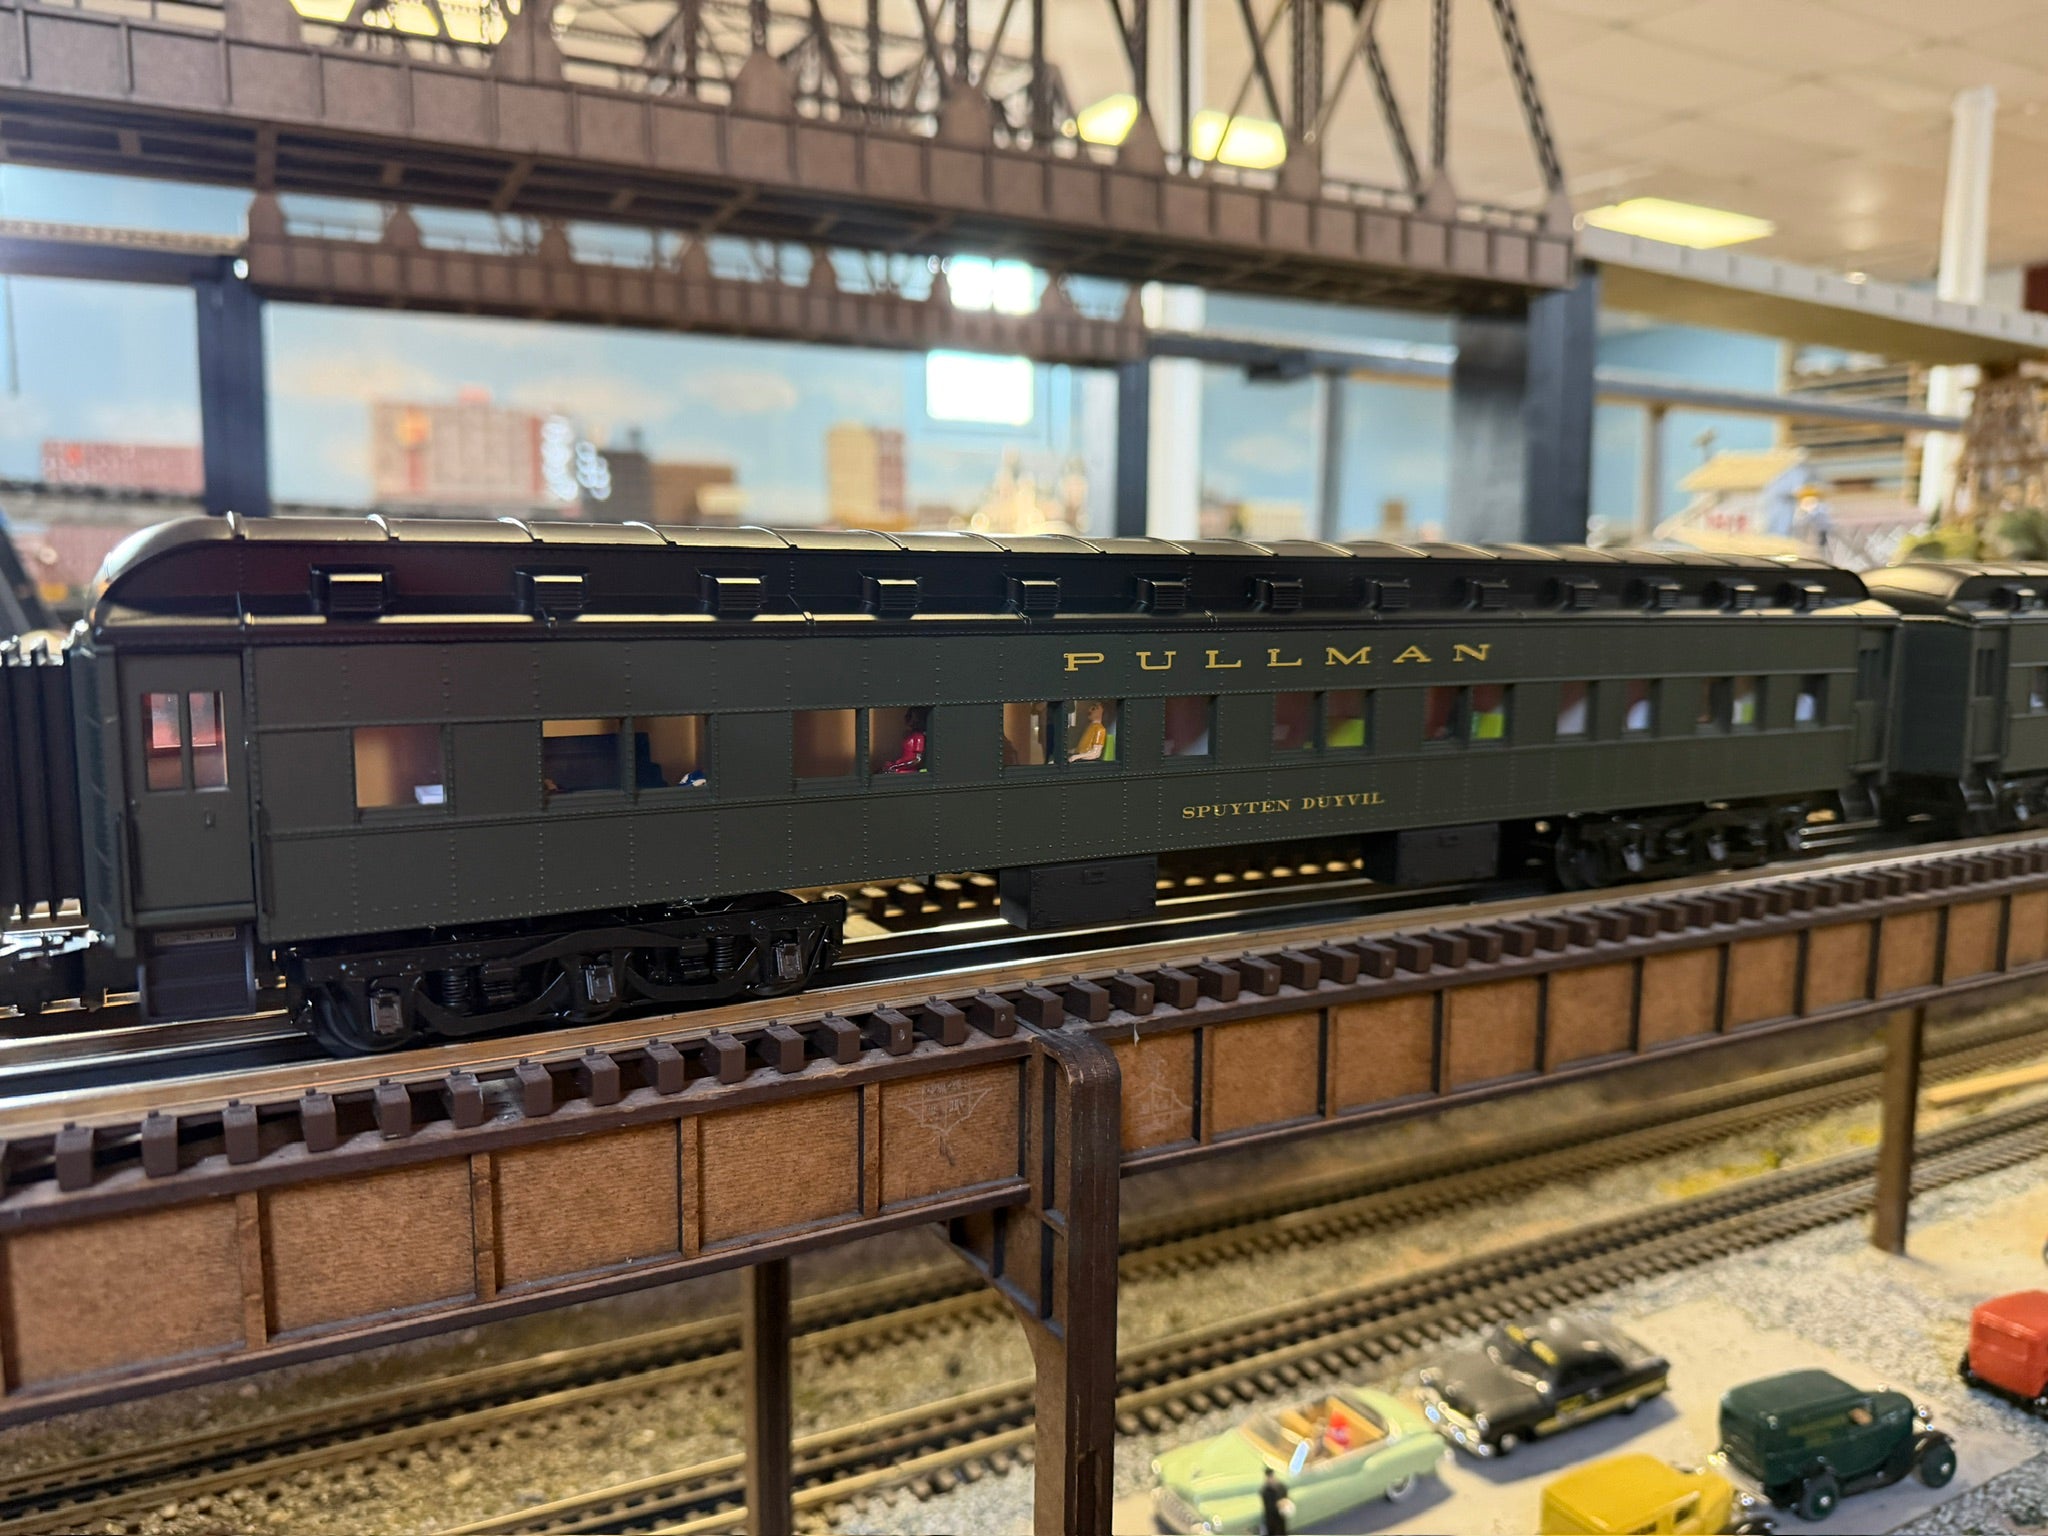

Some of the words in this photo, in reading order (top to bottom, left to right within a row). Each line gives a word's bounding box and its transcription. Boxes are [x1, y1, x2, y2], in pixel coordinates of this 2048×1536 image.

[1063, 644, 1491, 671] PULLMAN
[1182, 799, 1293, 819] SPUYTEN
[1301, 792, 1385, 810] DUYVIL
